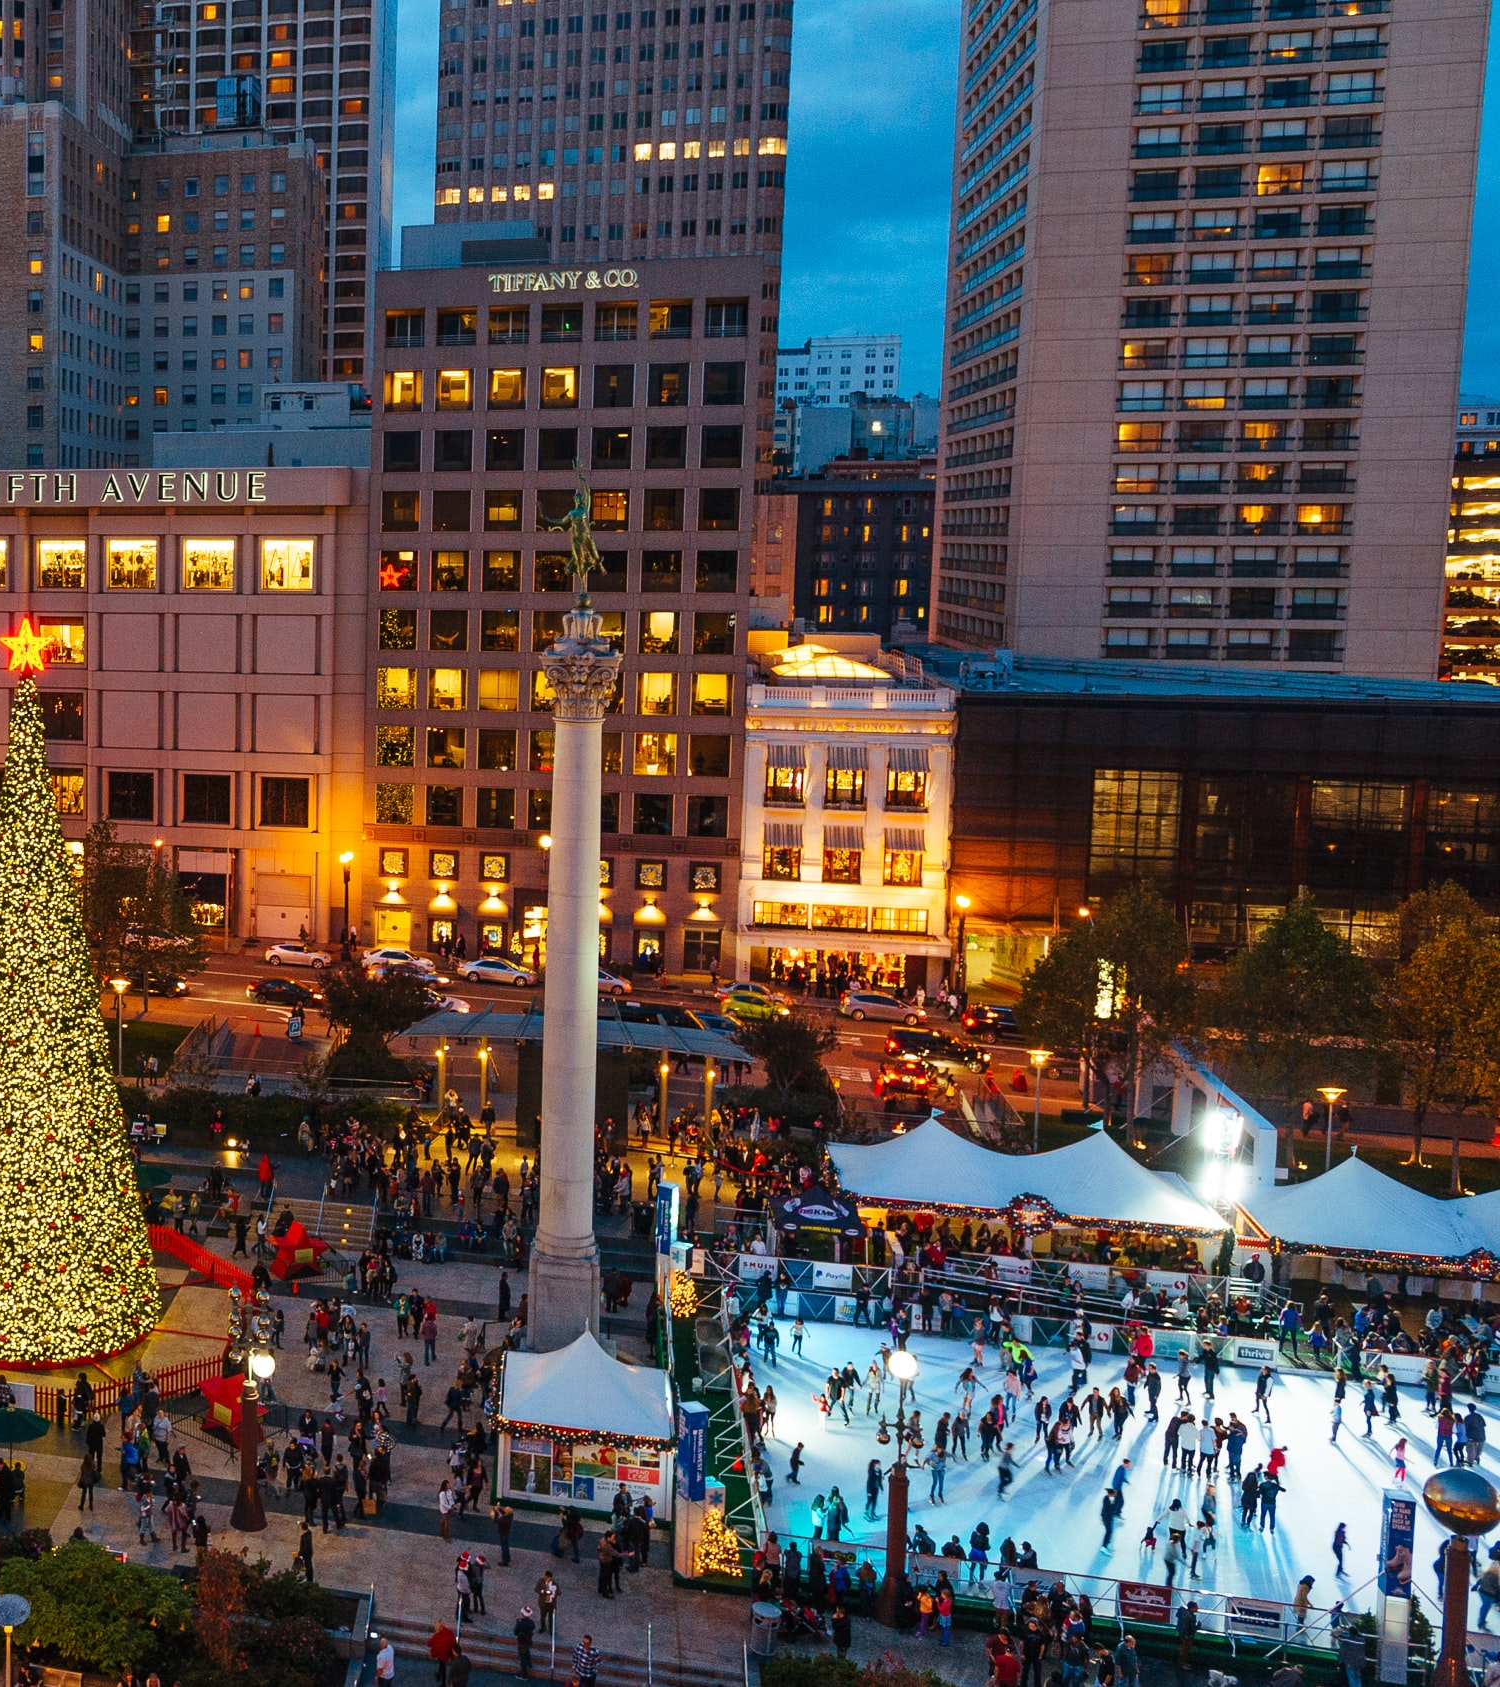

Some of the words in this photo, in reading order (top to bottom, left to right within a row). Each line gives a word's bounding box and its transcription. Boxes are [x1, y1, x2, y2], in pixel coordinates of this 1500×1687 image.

[488, 270, 582, 292] TIFFANY
[585, 270, 602, 289] &
[604, 269, 640, 289] CO.
[100, 471, 267, 503] AVENUE
[825, 1271, 851, 1281] PayPal
[1239, 1347, 1272, 1360] thrive
